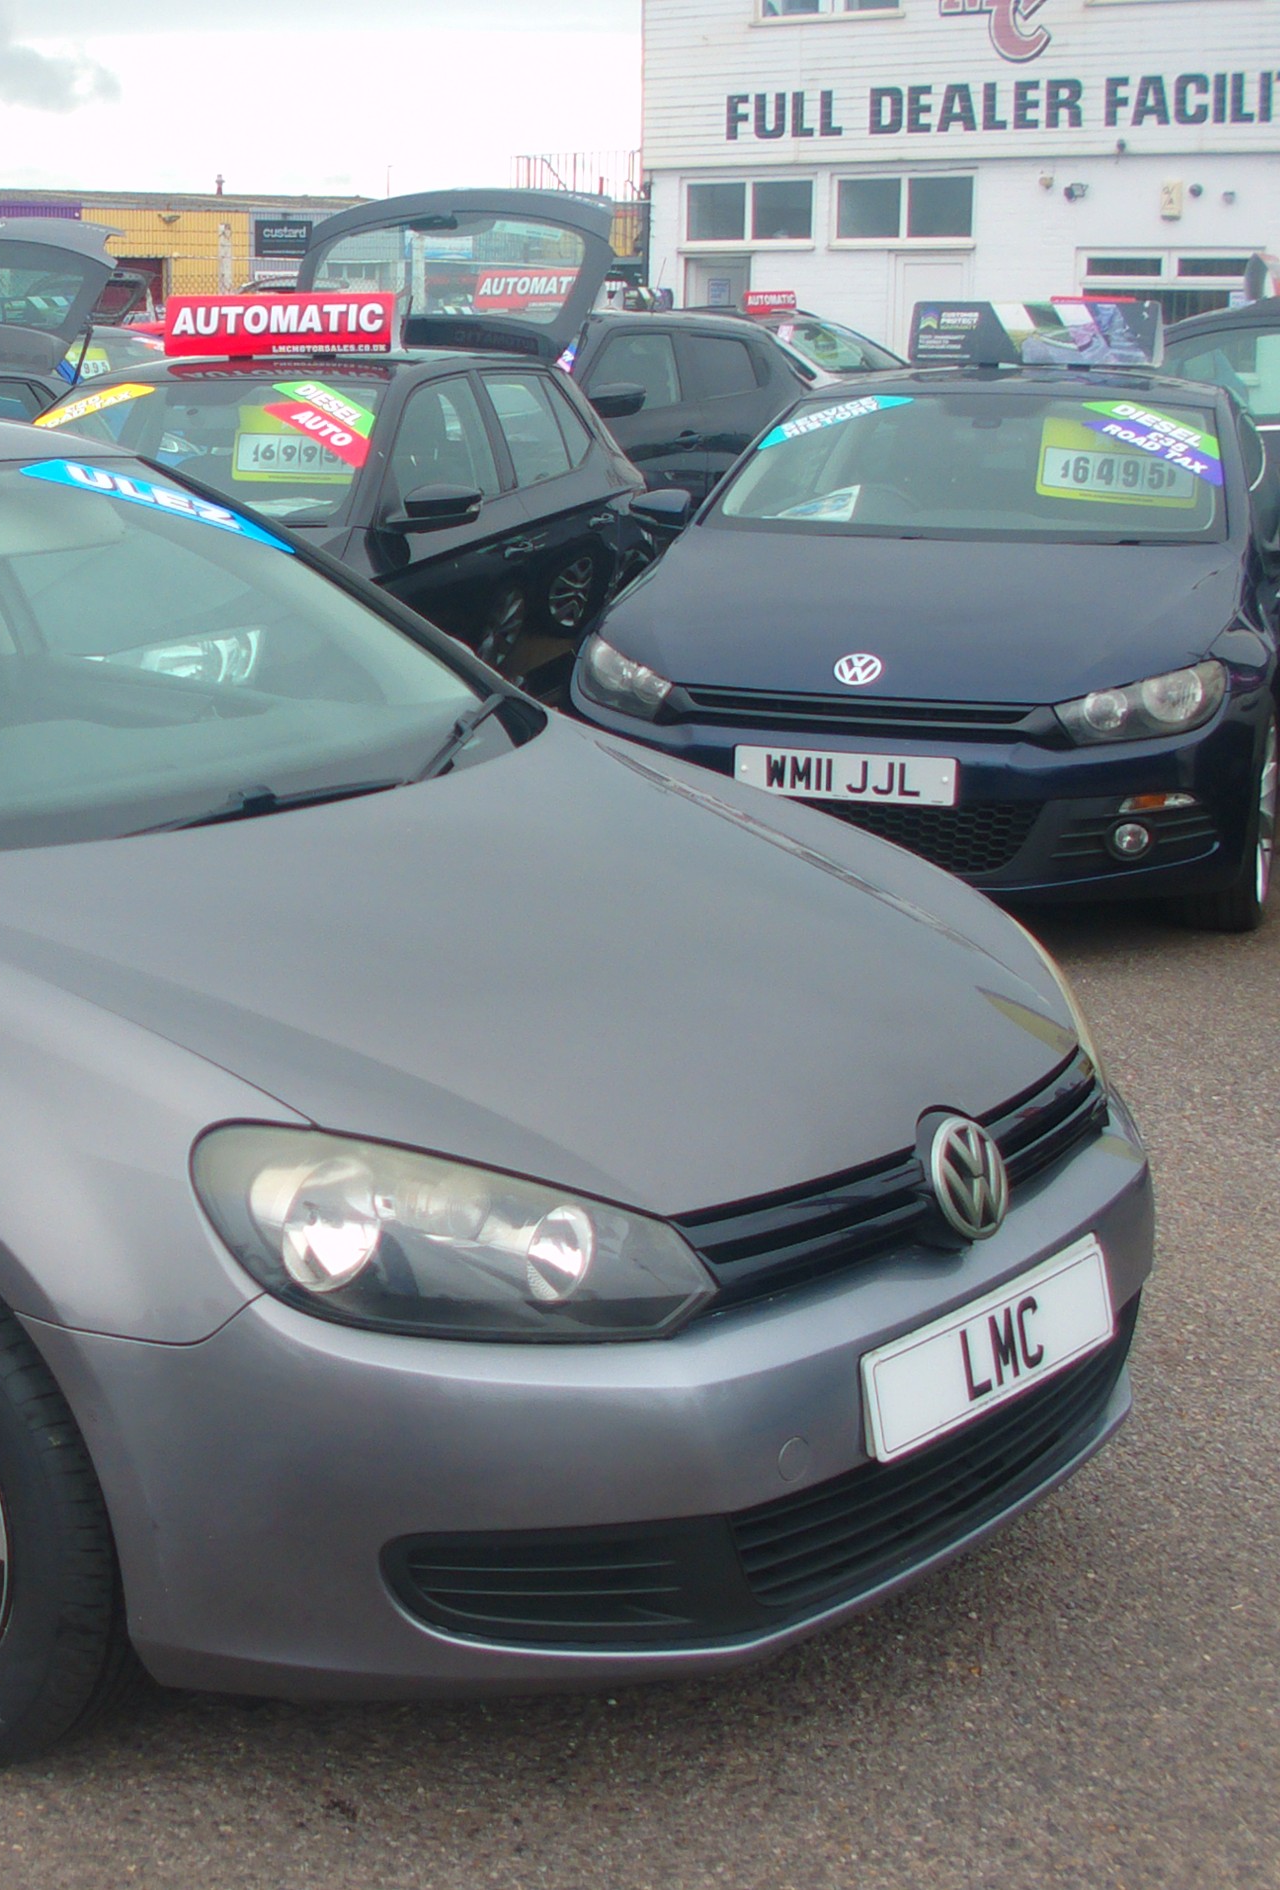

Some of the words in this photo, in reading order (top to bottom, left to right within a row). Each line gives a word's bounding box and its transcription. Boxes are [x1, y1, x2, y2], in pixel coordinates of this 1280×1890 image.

[726, 91, 843, 140] FULL
[869, 78, 1083, 135] DEALER
[1105, 71, 1280, 127] FACILI
[263, 226, 307, 238] custard
[479, 276, 576, 295] AUTOMAT
[748, 294, 796, 305] AUTOMATIC
[172, 303, 384, 335] AUTOMATIC
[39, 408, 86, 428] OAD
[93, 391, 132, 409] TAX
[294, 384, 362, 427] DIESEL
[780, 395, 876, 431] SERVICE
[784, 402, 879, 439] HISTORY
[291, 411, 353, 446] AUTO
[1111, 404, 1202, 448] DIESEL
[1102, 424, 1162, 451] ROAD
[1165, 450, 1208, 474] TAX
[66, 464, 244, 531] ULEZ
[833, 653, 882, 686] VW
[765, 753, 833, 792] WM11
[846, 760, 921, 798] JJL
[931, 1116, 1009, 1240] VW
[959, 1295, 1045, 1402] LMC
